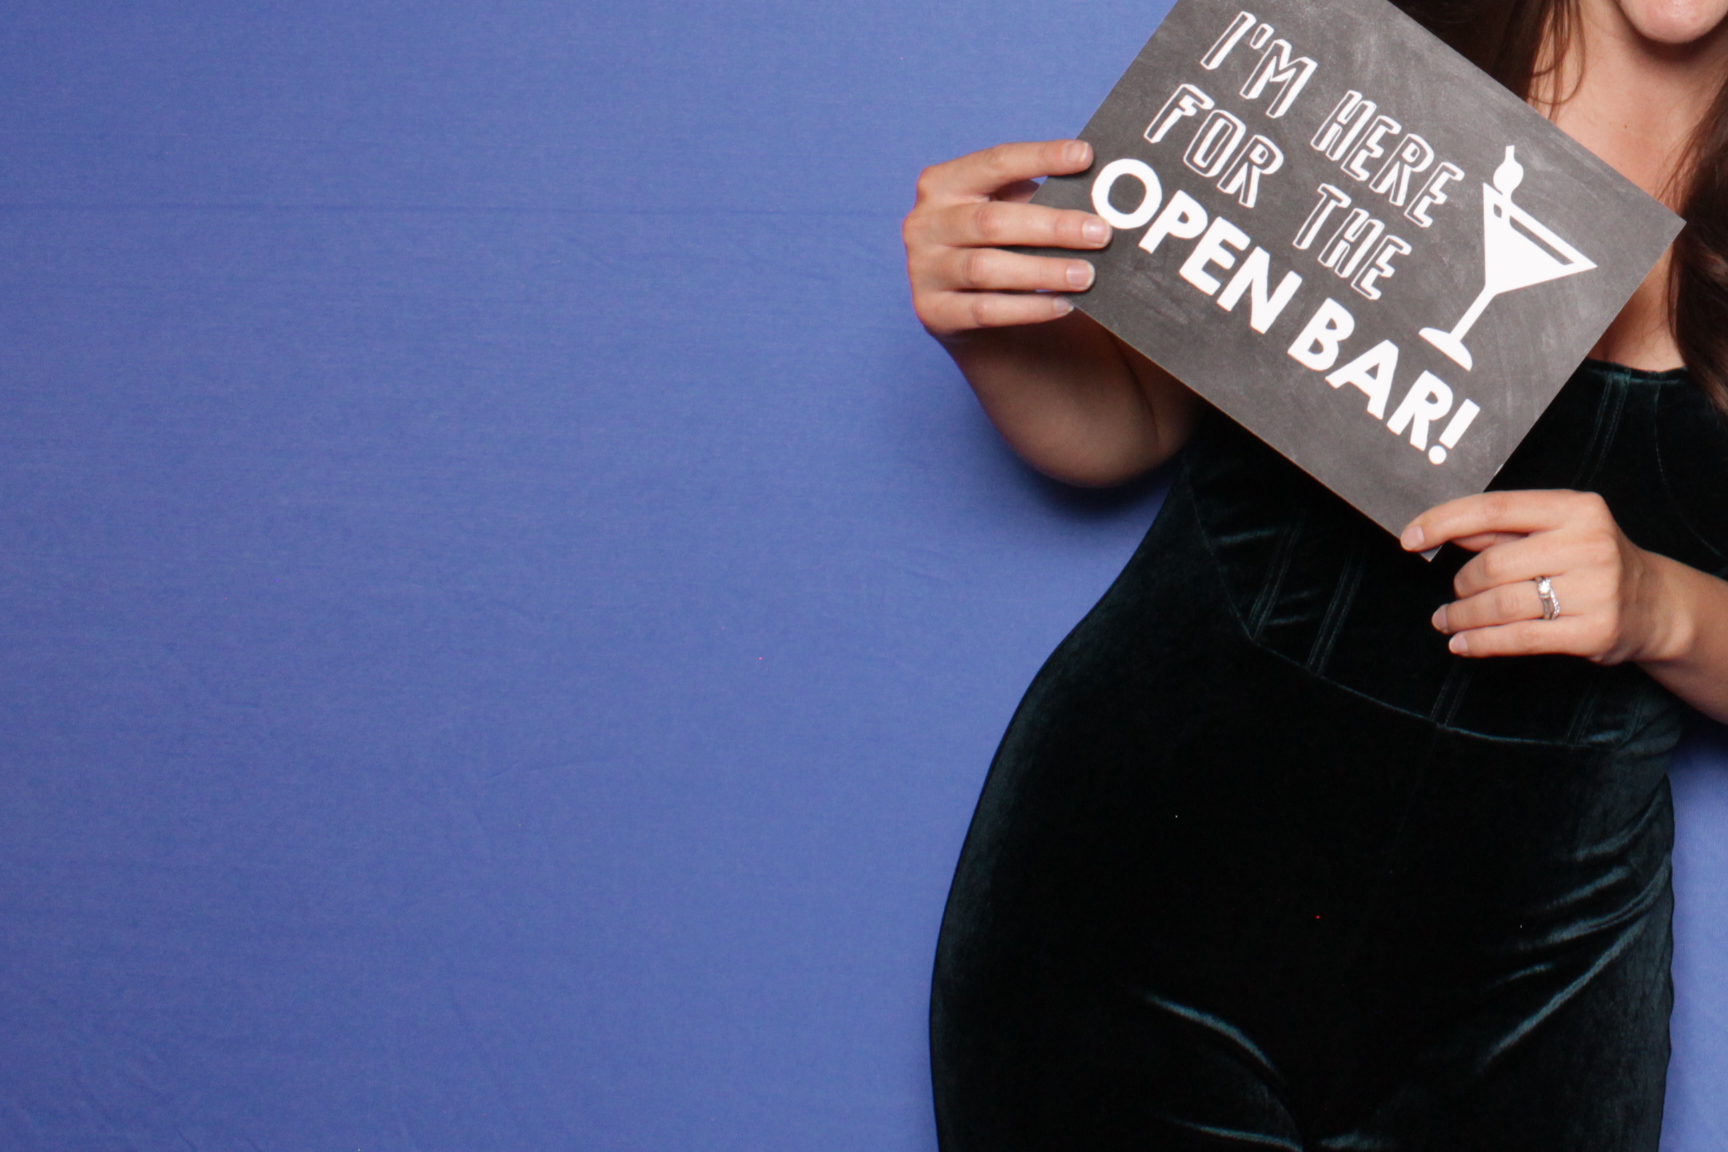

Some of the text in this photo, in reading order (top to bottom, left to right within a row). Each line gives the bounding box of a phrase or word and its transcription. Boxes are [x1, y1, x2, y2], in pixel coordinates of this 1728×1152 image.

[1144, 83, 1411, 300] FOR THE
[1200, 11, 1464, 228] I'M HERE
[1090, 158, 1481, 465] OPEN BAR!
